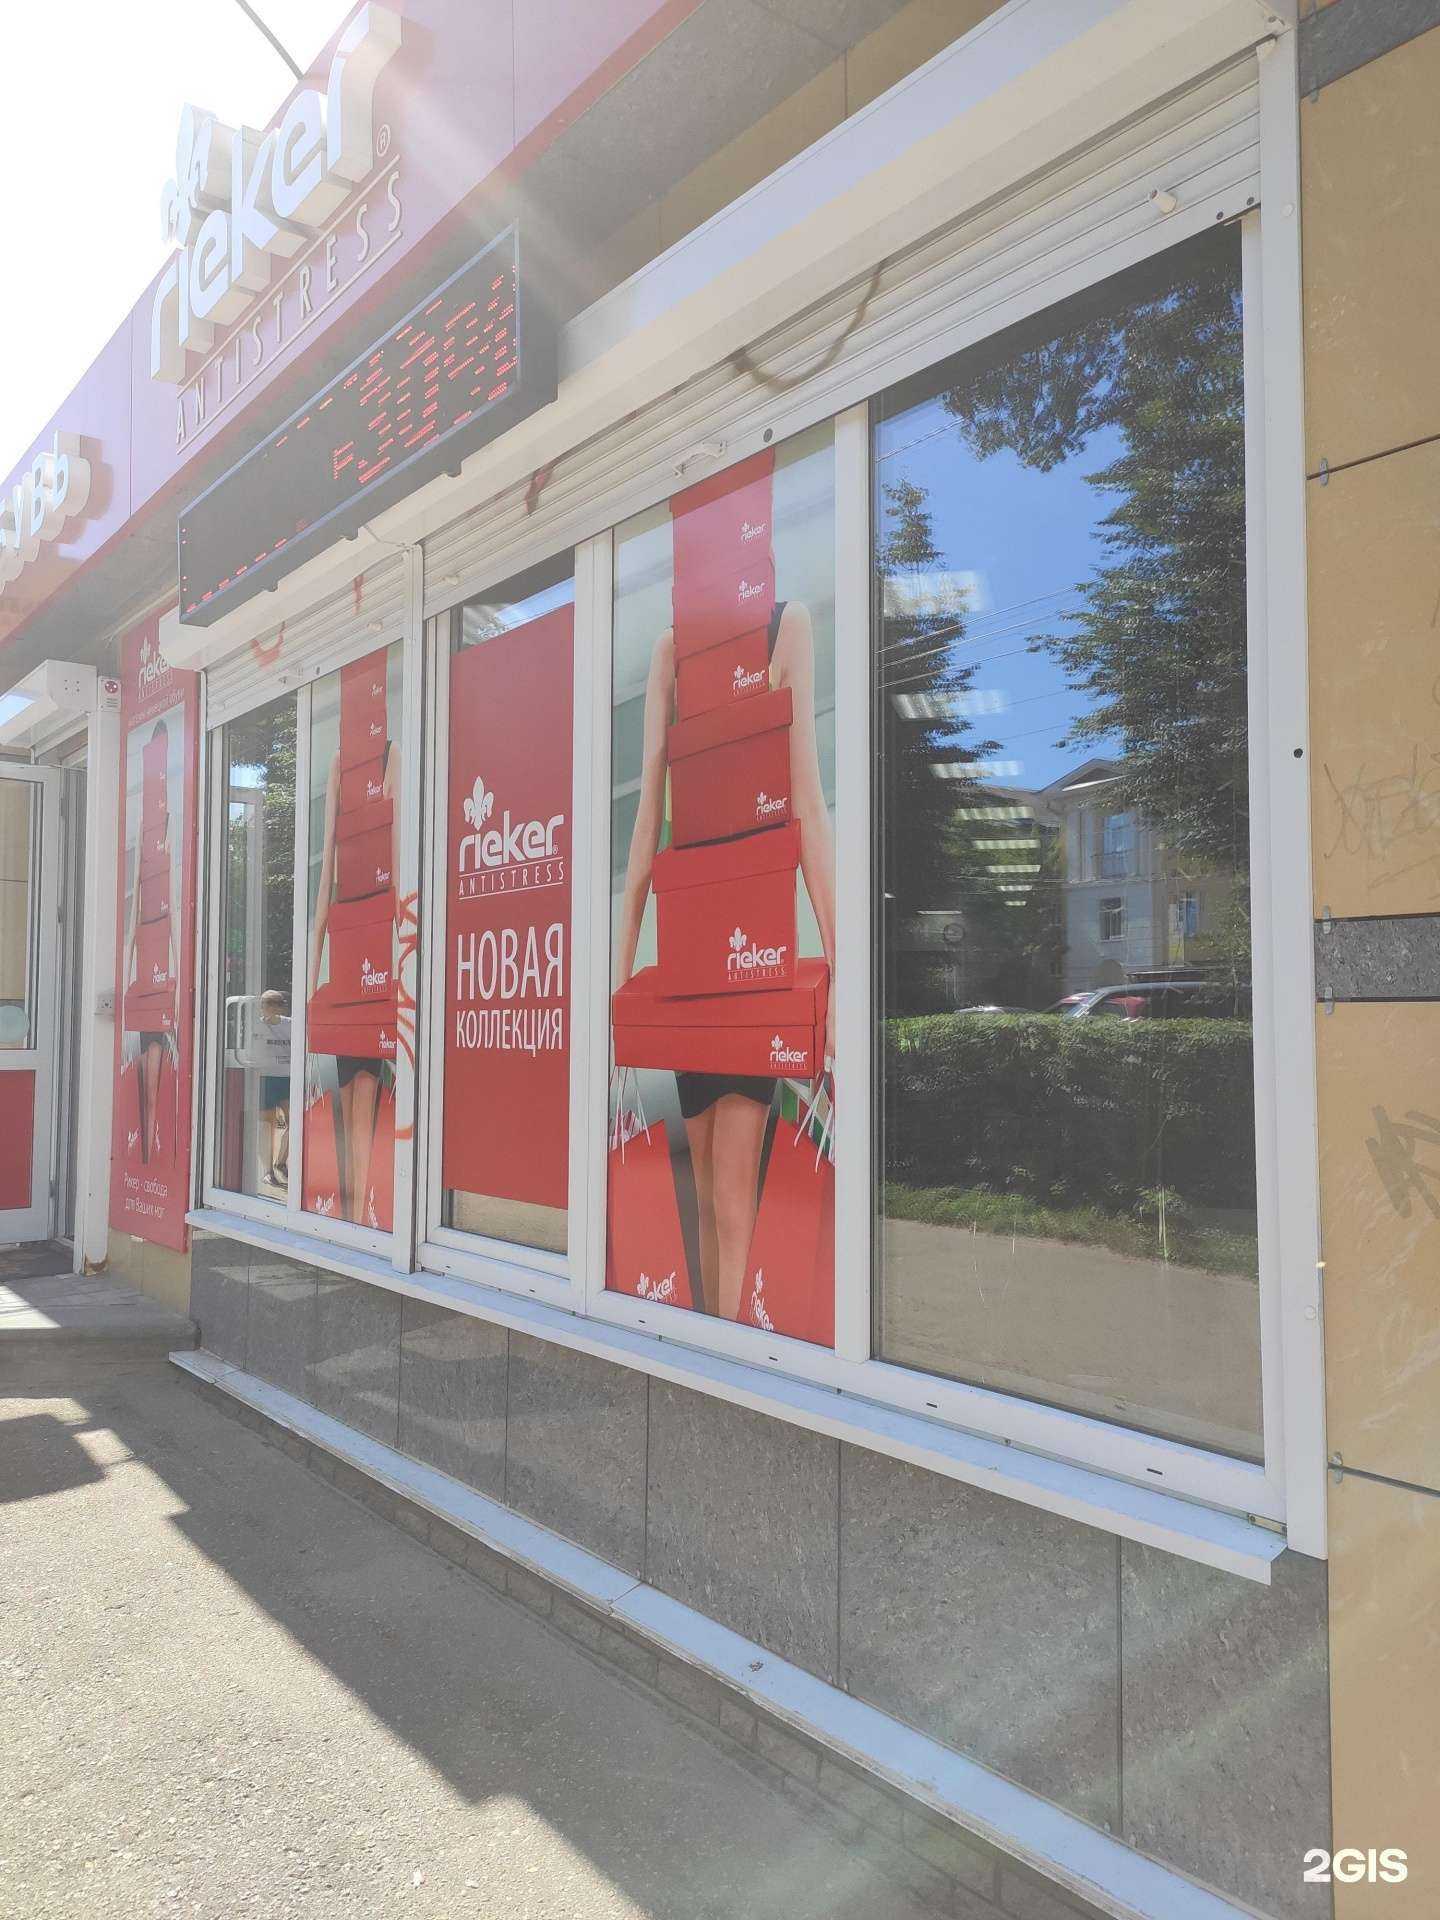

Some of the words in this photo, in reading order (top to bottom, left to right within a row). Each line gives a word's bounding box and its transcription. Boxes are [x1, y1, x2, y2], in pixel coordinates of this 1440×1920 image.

[151, 2, 374, 382] rieker
[176, 170, 403, 446] ANTISTRESS
[138, 651, 169, 691] rieke
[732, 669, 766, 690] rieker
[756, 797, 787, 815] rieker
[459, 810, 564, 872] rieker
[458, 861, 564, 896] ANTISTRESS
[457, 922, 563, 1001] НОВАЯ
[727, 942, 787, 970] rieker
[361, 968, 388, 986] rieker
[456, 1007, 563, 1058] КОЛЛЕКЦИЯ
[769, 1046, 808, 1062] rieker
